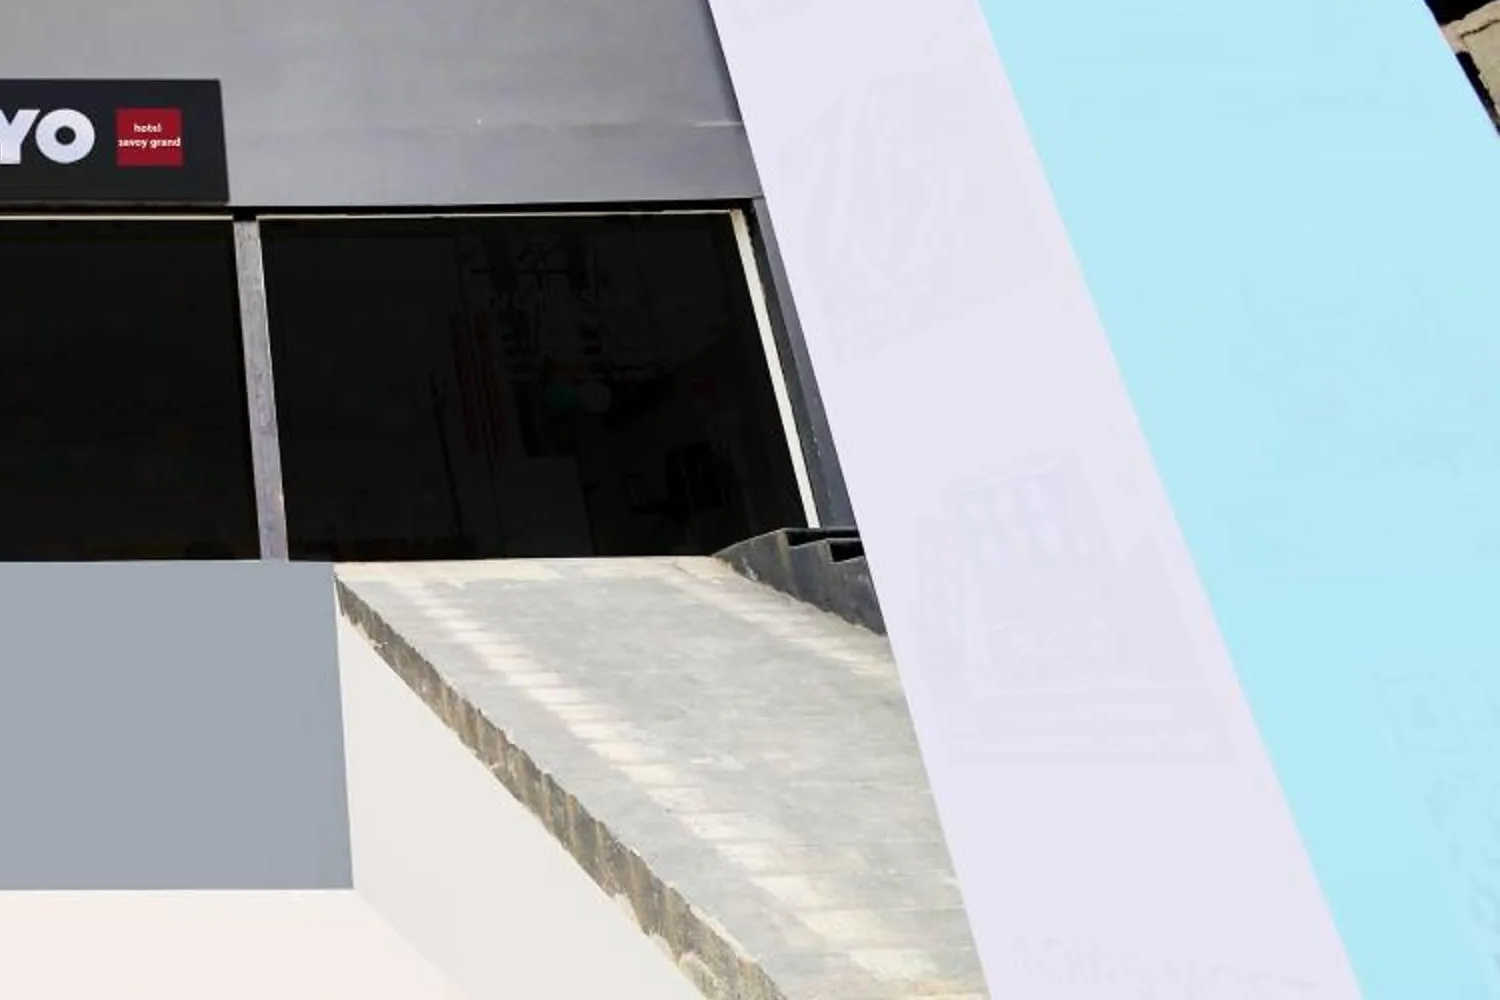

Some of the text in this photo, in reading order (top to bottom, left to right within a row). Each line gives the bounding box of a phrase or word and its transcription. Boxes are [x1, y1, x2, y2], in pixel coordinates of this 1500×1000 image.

[133, 122, 161, 133] hotel
[118, 137, 181, 149] savoy grand
